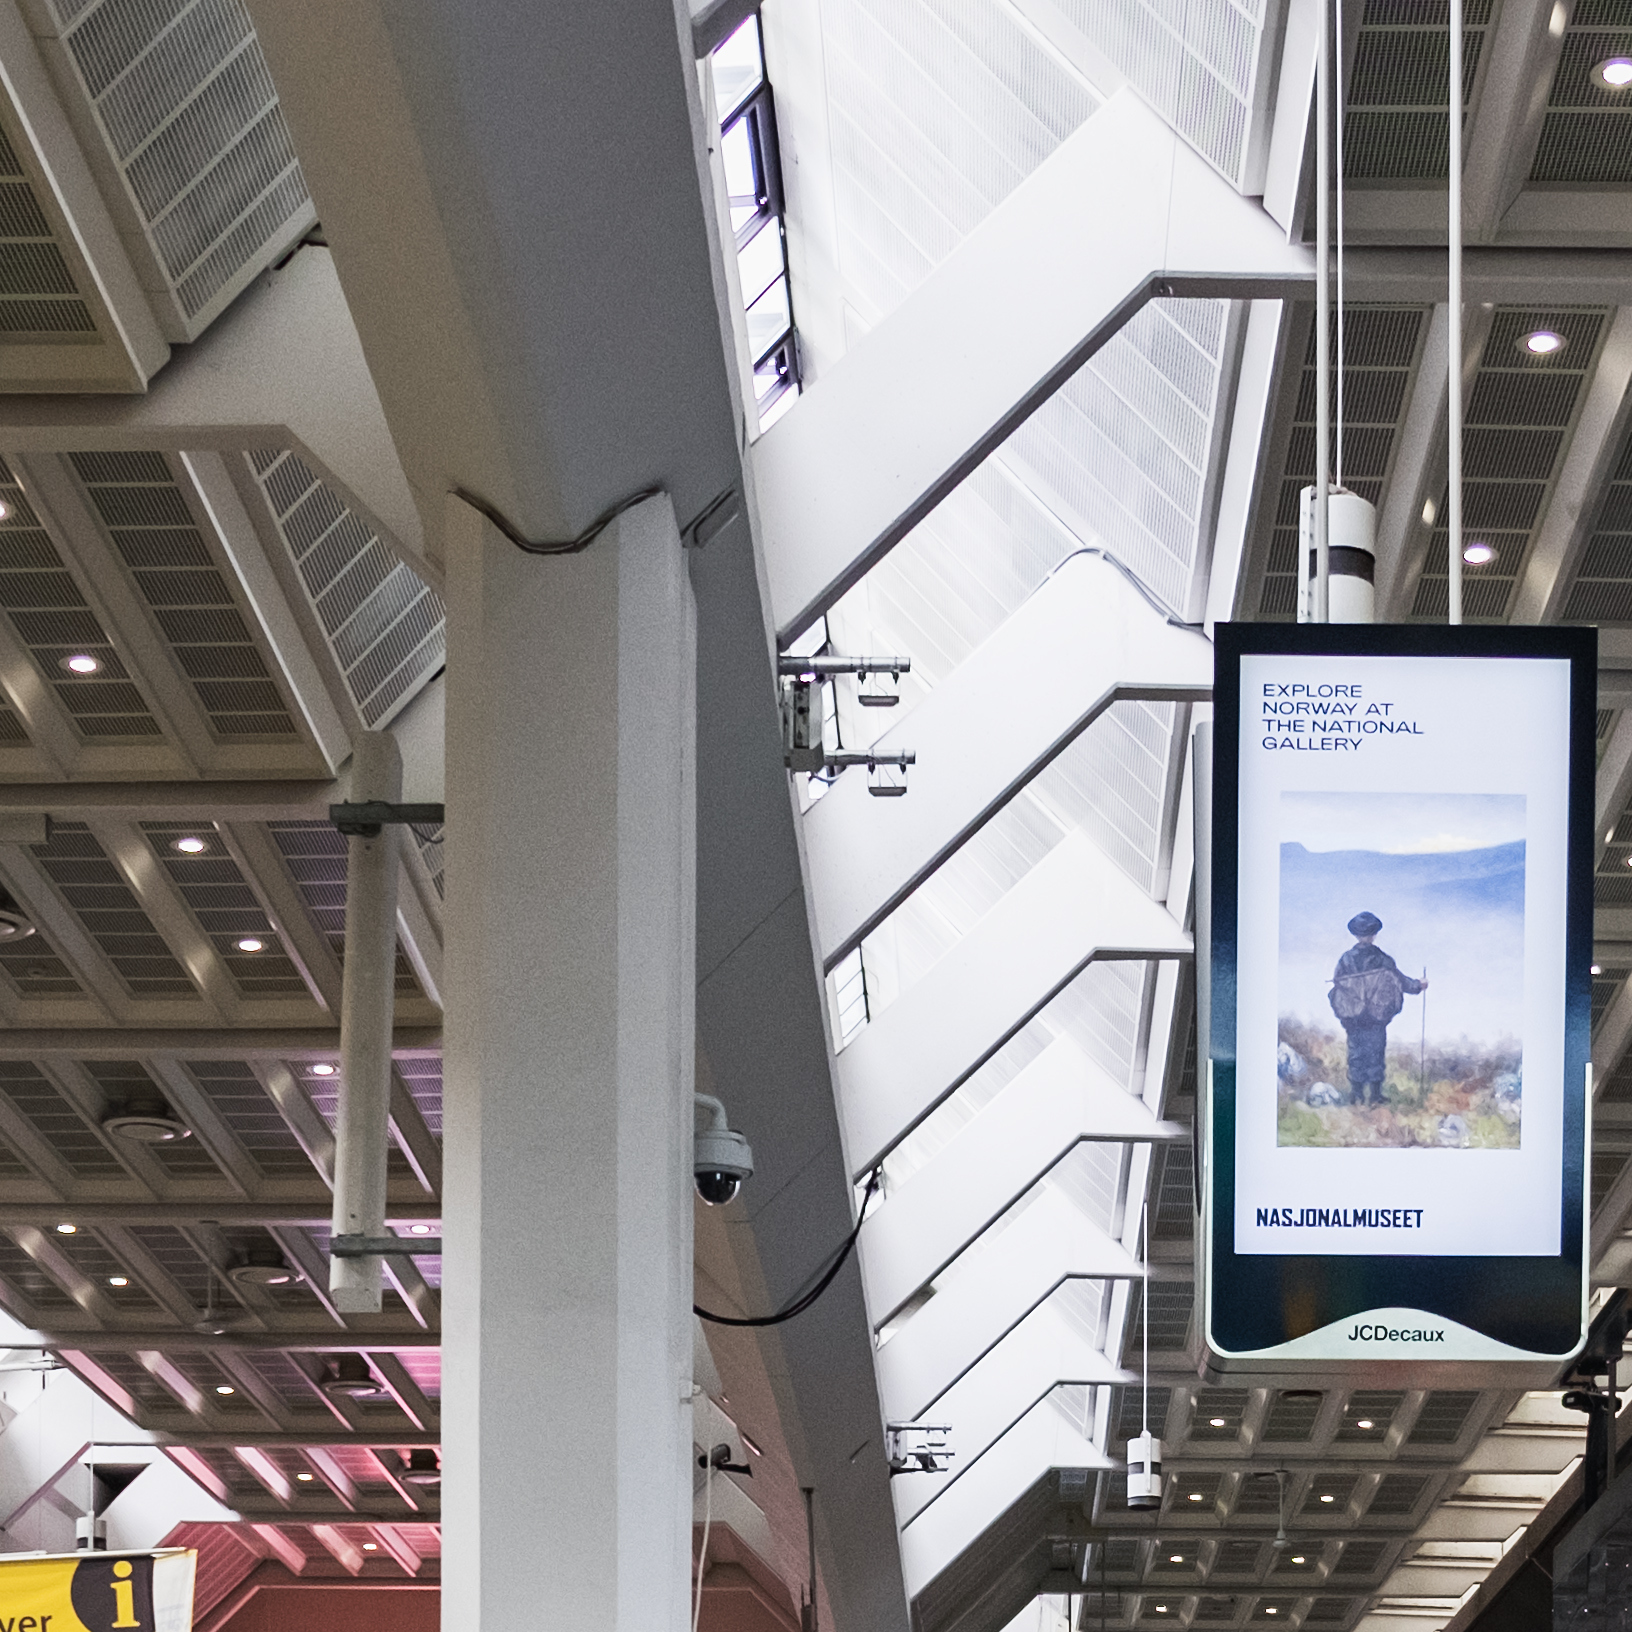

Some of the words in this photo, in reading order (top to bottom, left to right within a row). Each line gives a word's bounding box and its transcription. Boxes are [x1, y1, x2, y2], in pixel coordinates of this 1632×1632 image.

[1262, 682, 1363, 699] EXPLORE
[1261, 701, 1357, 717] NORWAY
[1365, 701, 1392, 717] AT
[1261, 719, 1307, 736] THE
[1311, 718, 1424, 735] NATIONAL
[1261, 736, 1364, 753] GALLERY
[1256, 1208, 1423, 1230] NASJONALMUSEET
[1347, 1322, 1445, 1345] JCDecaux
